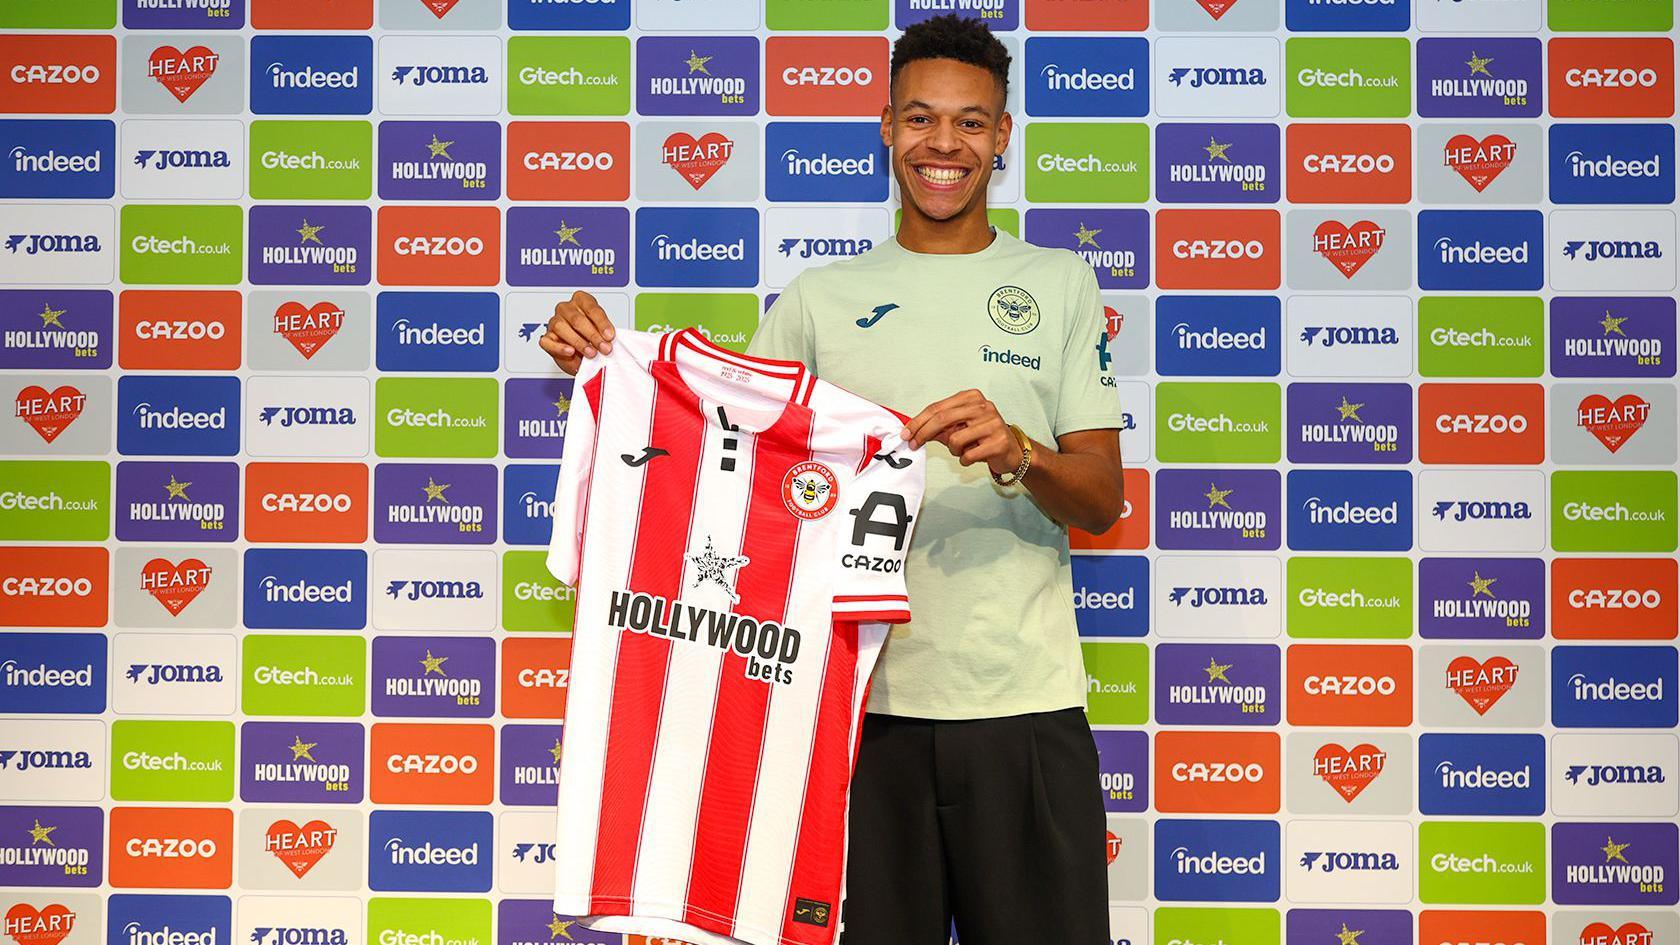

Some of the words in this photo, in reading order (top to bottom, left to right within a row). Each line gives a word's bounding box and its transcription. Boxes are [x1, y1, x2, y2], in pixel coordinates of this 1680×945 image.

[209, 7, 231, 17] bets
[982, 8, 1005, 19] bets
[11, 66, 99, 83] CAZOO
[150, 56, 218, 76] HEART
[274, 67, 357, 87] indeed
[519, 67, 618, 85] Gtech.co.uk
[783, 67, 872, 85] CAZOO
[1049, 68, 1133, 89] indeed
[1298, 69, 1399, 87] Gtech.co.uk
[1566, 69, 1656, 86] CAZOO
[651, 78, 744, 94] HOLLYWOOD
[1432, 80, 1527, 96] HOLLYWOOD
[722, 93, 745, 103] bets
[1504, 95, 1527, 106] bets
[17, 151, 100, 171] indeed
[262, 151, 360, 169] Gtech.co.uk
[524, 152, 613, 170] CAZOO
[664, 142, 733, 162] HEART
[1446, 144, 1516, 165] HEART
[393, 163, 486, 181] HOLLYWOOD
[789, 154, 873, 174] indeed
[1037, 154, 1137, 172] Gtech.co.uk
[1304, 155, 1394, 173] CAZOO
[1573, 155, 1659, 176] indeed
[1171, 165, 1265, 181] HOLLYWOOD
[463, 178, 485, 188] bets
[1242, 181, 1265, 191] bets
[133, 236, 230, 253] Gtech.co.uk
[394, 237, 483, 255] CAZOO
[659, 239, 743, 260] indeed
[1173, 240, 1263, 258] CAZOO
[1315, 230, 1385, 251] HEART
[264, 247, 356, 264] HOLLYWOOD
[521, 249, 614, 265] HOLLYWOOD
[1442, 242, 1527, 263] indeed
[333, 263, 355, 273] bets
[591, 264, 614, 274] bets
[1112, 266, 1134, 276] bets
[136, 321, 224, 339] CAZOO
[275, 312, 343, 332] HEART
[6, 332, 98, 347] HOLLYWOOD
[399, 323, 484, 344] indeed
[1179, 327, 1265, 349] indeed
[1431, 328, 1532, 346] Gtech.co.uk
[75, 347, 97, 357] bets
[1566, 339, 1661, 355] HOLLYWOOD
[983, 348, 1041, 371] indeed
[1637, 356, 1661, 366] bets
[16, 397, 84, 417] HEART
[1579, 405, 1650, 426] HEART
[140, 407, 225, 428] indeed
[387, 409, 486, 427] Gtech.co.uk
[1168, 414, 1268, 432] Gtech.co.uk
[1436, 415, 1527, 433] CAZOO
[519, 420, 566, 437] HOLLY
[1303, 425, 1397, 442] HOLLYWOOD
[1374, 441, 1397, 451] bets
[792, 464, 834, 482] BRENTFORD
[0, 492, 97, 509] Gtech.co.uk
[262, 494, 351, 512] CAZOO
[131, 504, 224, 520] HOLLYWOOD
[389, 506, 482, 525] HOLLYWOOD
[1171, 512, 1266, 528] HOLLYWOOD
[1311, 502, 1396, 523] indeed
[1564, 503, 1665, 520] Gtech.co.uk
[200, 520, 223, 530] bets
[459, 521, 481, 532] bets
[1242, 527, 1265, 537] bets
[842, 554, 901, 573] CAZOO
[3, 578, 91, 595] CAZOO
[142, 570, 210, 590] HEART
[267, 580, 351, 602] indeed
[1073, 587, 1134, 610] deed
[1299, 589, 1400, 607] Gtech.co.uk
[1569, 590, 1660, 608] CAZOO
[1434, 600, 1530, 617] HOLLYWOOD
[608, 590, 801, 664] HOLLYWOOD
[1506, 616, 1529, 627] bets
[7, 664, 91, 686] indeed
[255, 667, 353, 685] Gtech.co.uk
[518, 668, 569, 688] CAZ
[748, 656, 793, 685] bets
[1448, 667, 1518, 687] HEART
[387, 679, 480, 696] HOLLYWOOD
[1087, 675, 1136, 693] h.co.uk
[1304, 676, 1395, 695] CAZOO
[1576, 678, 1662, 699] indeed
[457, 695, 479, 705] bets
[1170, 686, 1265, 703] HOLLYWOOD
[1242, 702, 1265, 712] bets
[123, 752, 222, 770] Gtech.co.uk
[387, 755, 477, 773] CAZOO
[1316, 753, 1386, 774] HEART
[255, 764, 349, 782] HOLLYWOOD
[514, 767, 560, 784] HOLLY
[1172, 763, 1263, 782] CAZOO
[1444, 763, 1529, 787] indeed
[326, 780, 348, 790] bets
[1110, 789, 1133, 800] bets
[127, 839, 216, 857] CAZOO
[267, 831, 336, 851] HEART
[393, 842, 477, 865] indeed
[1179, 848, 1264, 874] indeed
[65, 865, 88, 875] bets
[1432, 854, 1532, 872] Gtech.co.uk
[1567, 866, 1663, 883] HOLLYWOOD
[1640, 881, 1664, 892] bets
[7, 916, 75, 936] HEART
[132, 927, 215, 945] indeed
